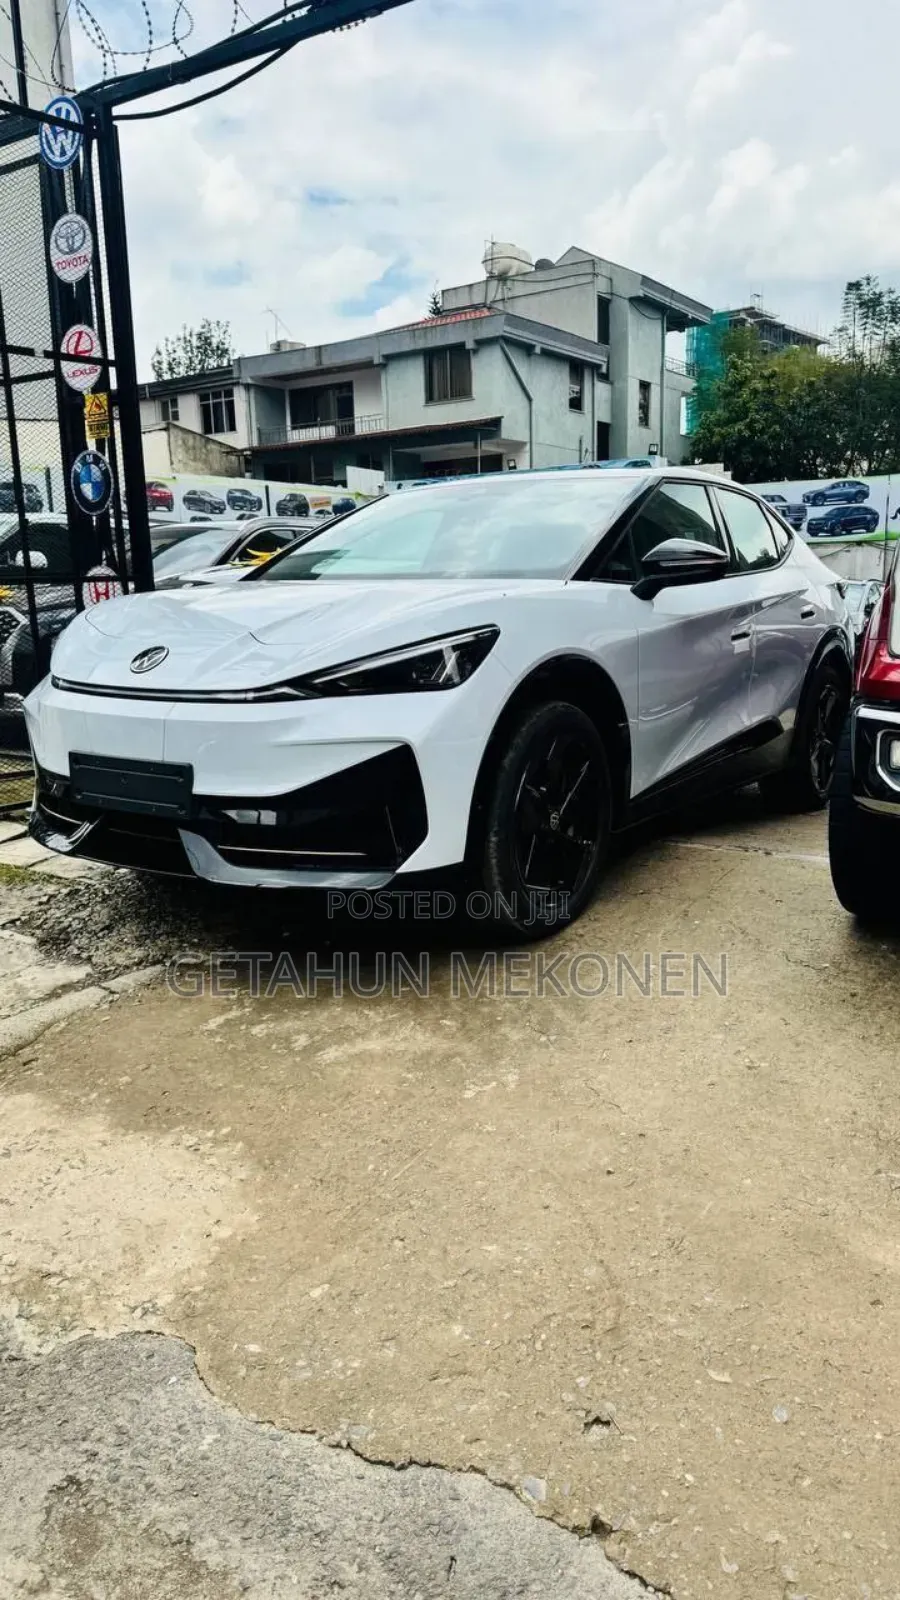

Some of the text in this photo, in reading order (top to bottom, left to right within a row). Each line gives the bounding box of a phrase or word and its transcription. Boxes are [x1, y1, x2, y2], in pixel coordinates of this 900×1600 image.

[56, 255, 89, 270] TOYOTA
[67, 366, 98, 378] LEXUS
[74, 454, 107, 473] BMW
